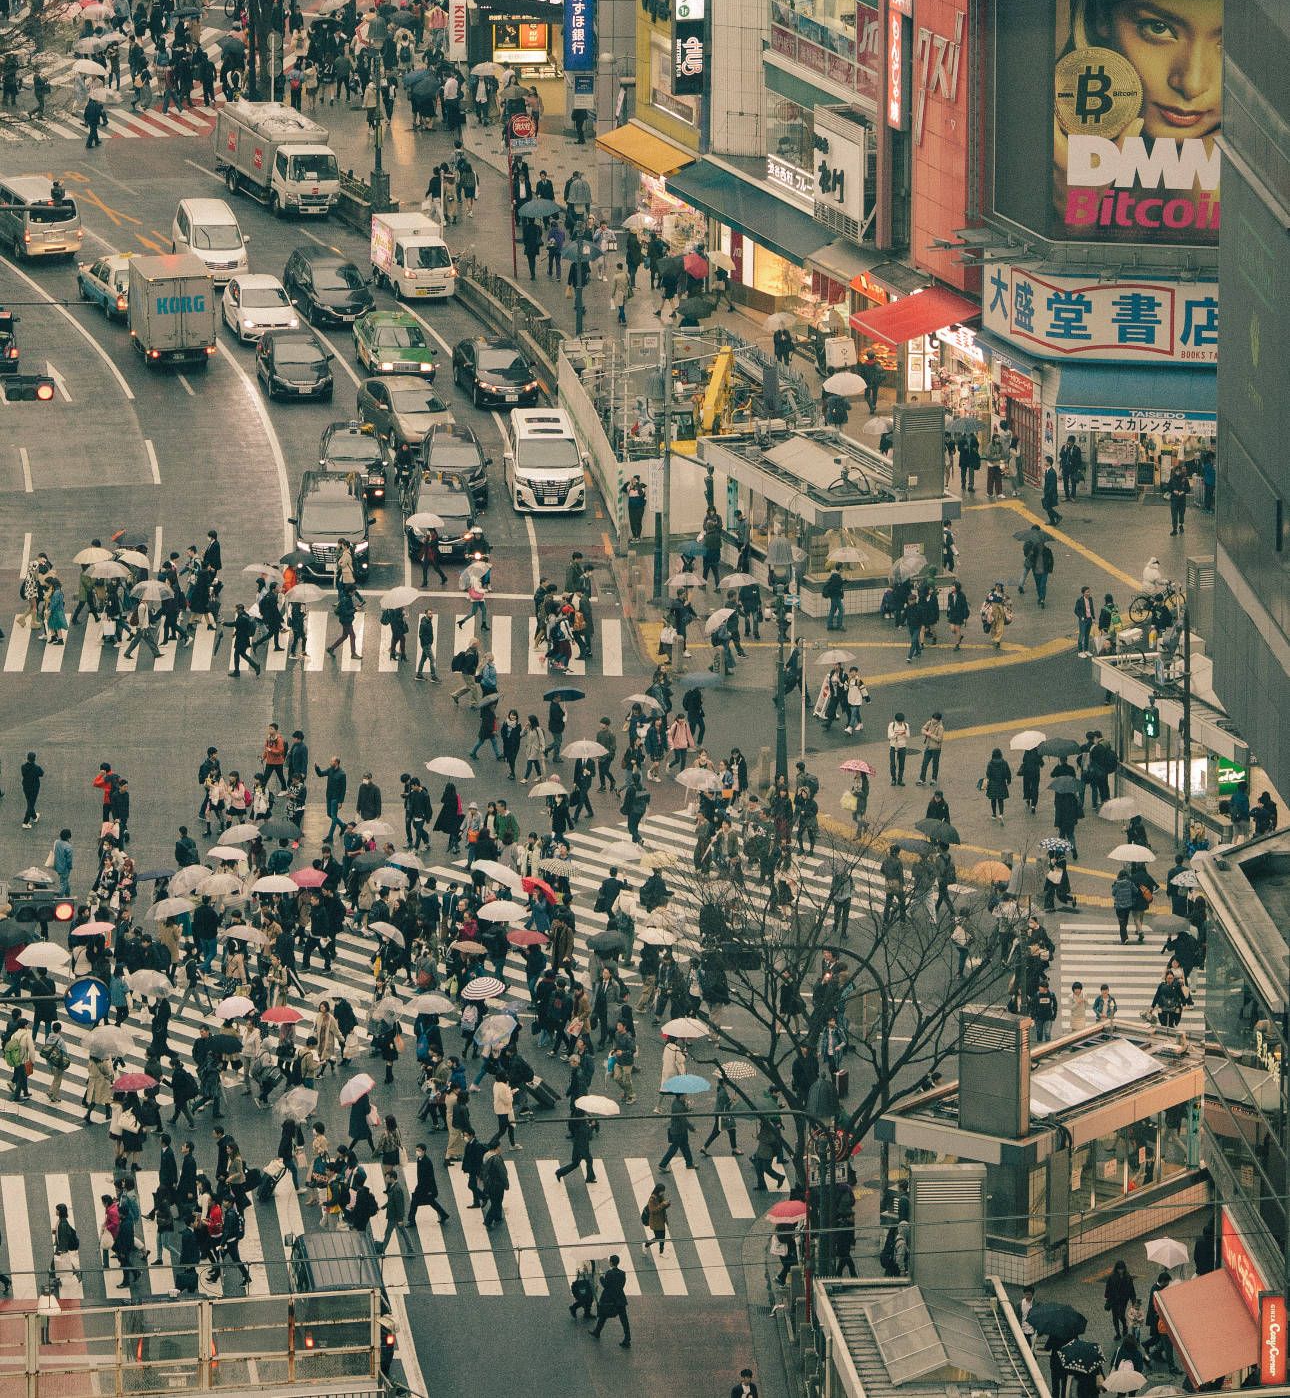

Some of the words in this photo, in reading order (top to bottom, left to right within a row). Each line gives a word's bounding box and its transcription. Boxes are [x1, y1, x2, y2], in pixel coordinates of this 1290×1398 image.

[454, 4, 465, 44] KIRIN
[681, 36, 703, 77] HUB
[914, 10, 965, 145] クスリ
[157, 295, 205, 315] KORG
[989, 268, 1219, 346] 大盛堂書店
[1181, 350, 1206, 360] BOOKS
[1128, 409, 1186, 420] TAISEIDO
